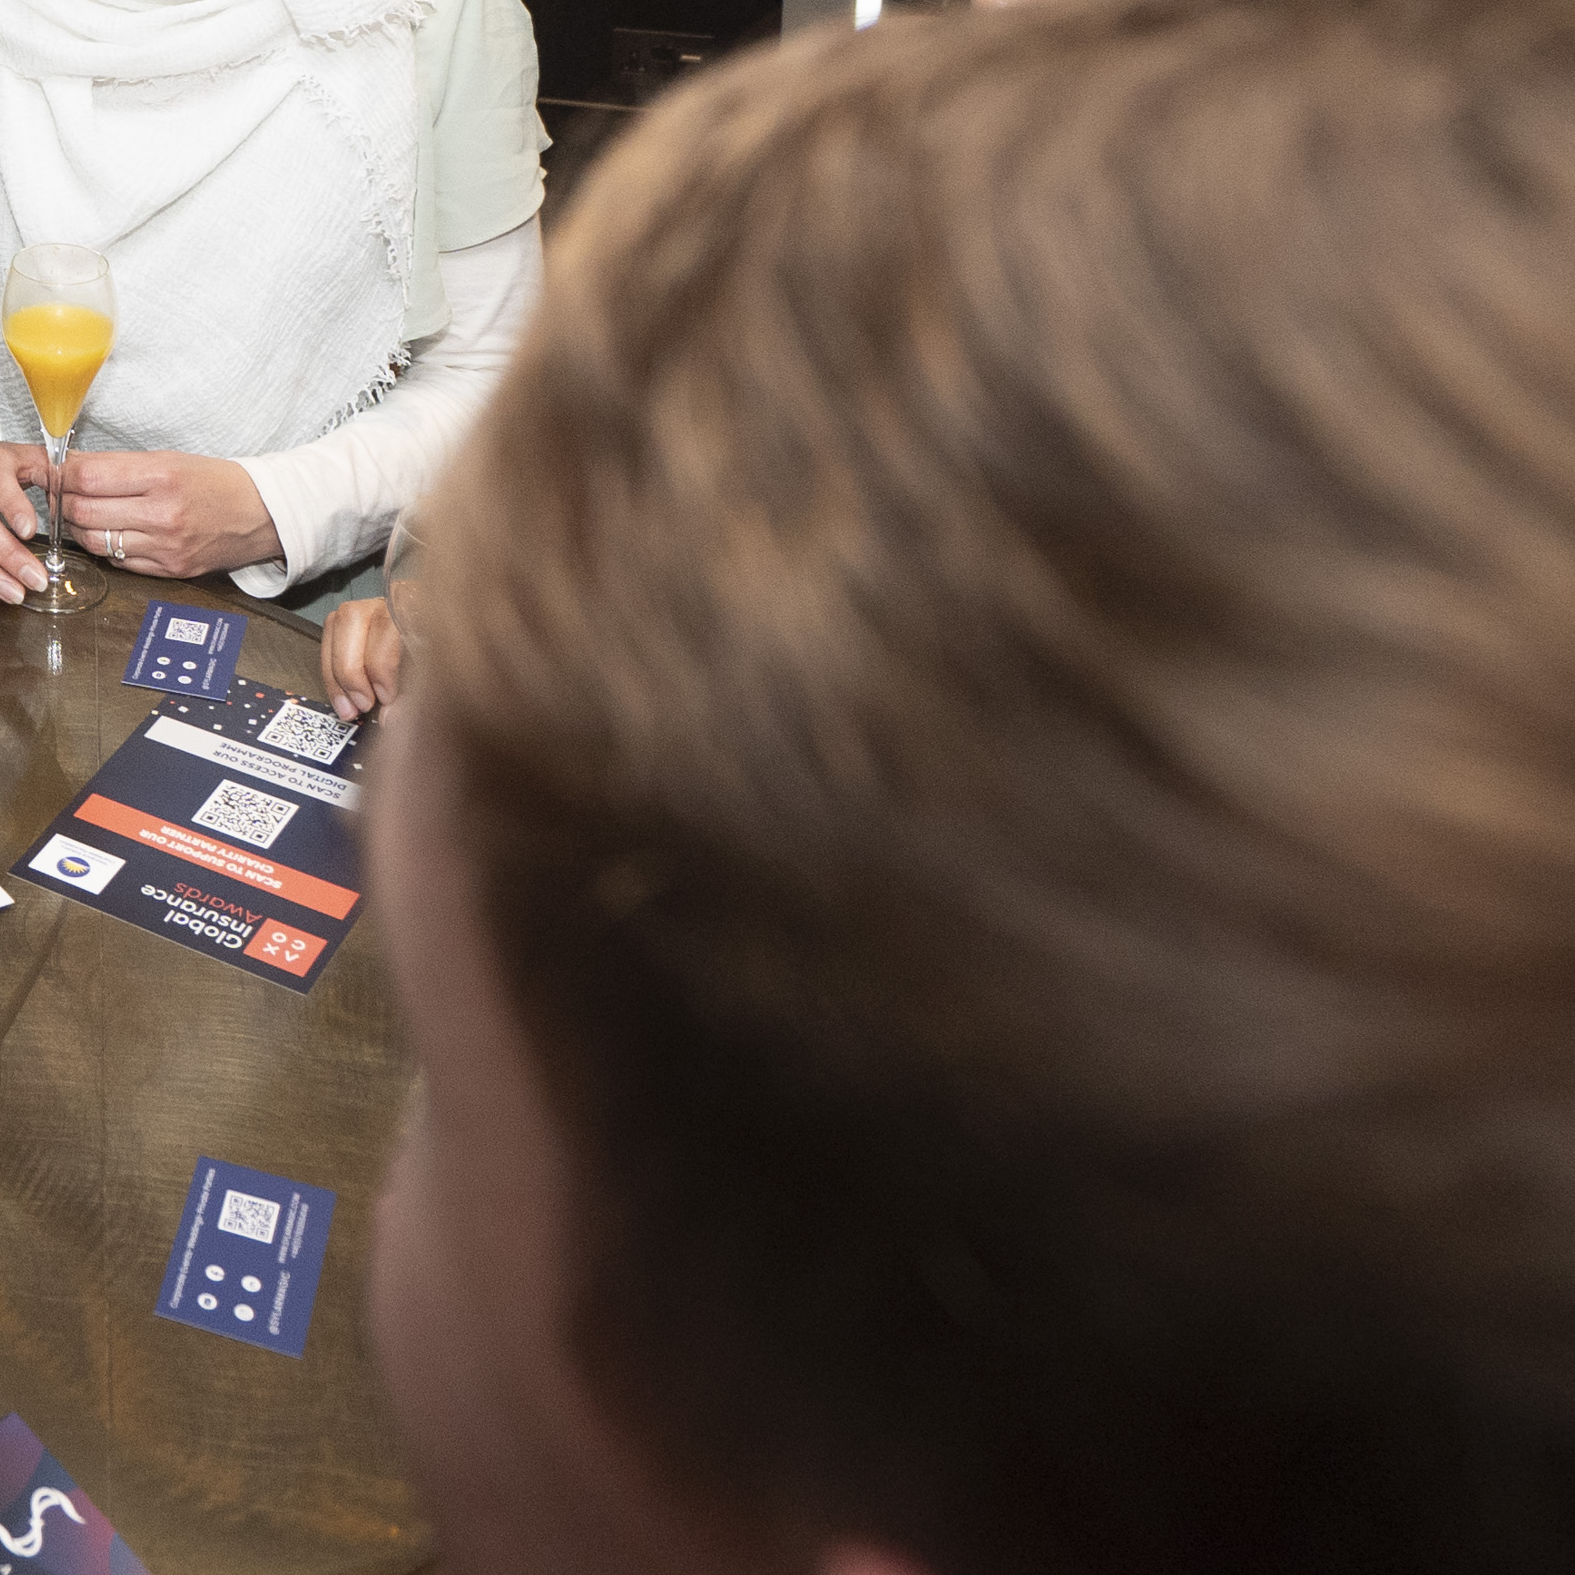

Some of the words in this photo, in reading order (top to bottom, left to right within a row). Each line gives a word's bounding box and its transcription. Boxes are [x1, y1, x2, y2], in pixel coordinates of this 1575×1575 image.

[212, 750, 239, 762] OUR
[221, 742, 296, 773] PROGRAMME
[240, 760, 288, 779] ACCESS
[299, 769, 347, 790] DIGITAL
[288, 776, 304, 786] TO
[306, 783, 341, 799] SCAN
[139, 829, 168, 845] OUR
[160, 826, 218, 853] PARTNER
[166, 839, 227, 867] SUPPORT
[216, 846, 274, 874] CHARITY
[226, 862, 248, 876] TO
[244, 869, 282, 889] SCAN
[141, 884, 253, 938] Insurance
[173, 882, 263, 923] Awards
[163, 910, 243, 949] Global
